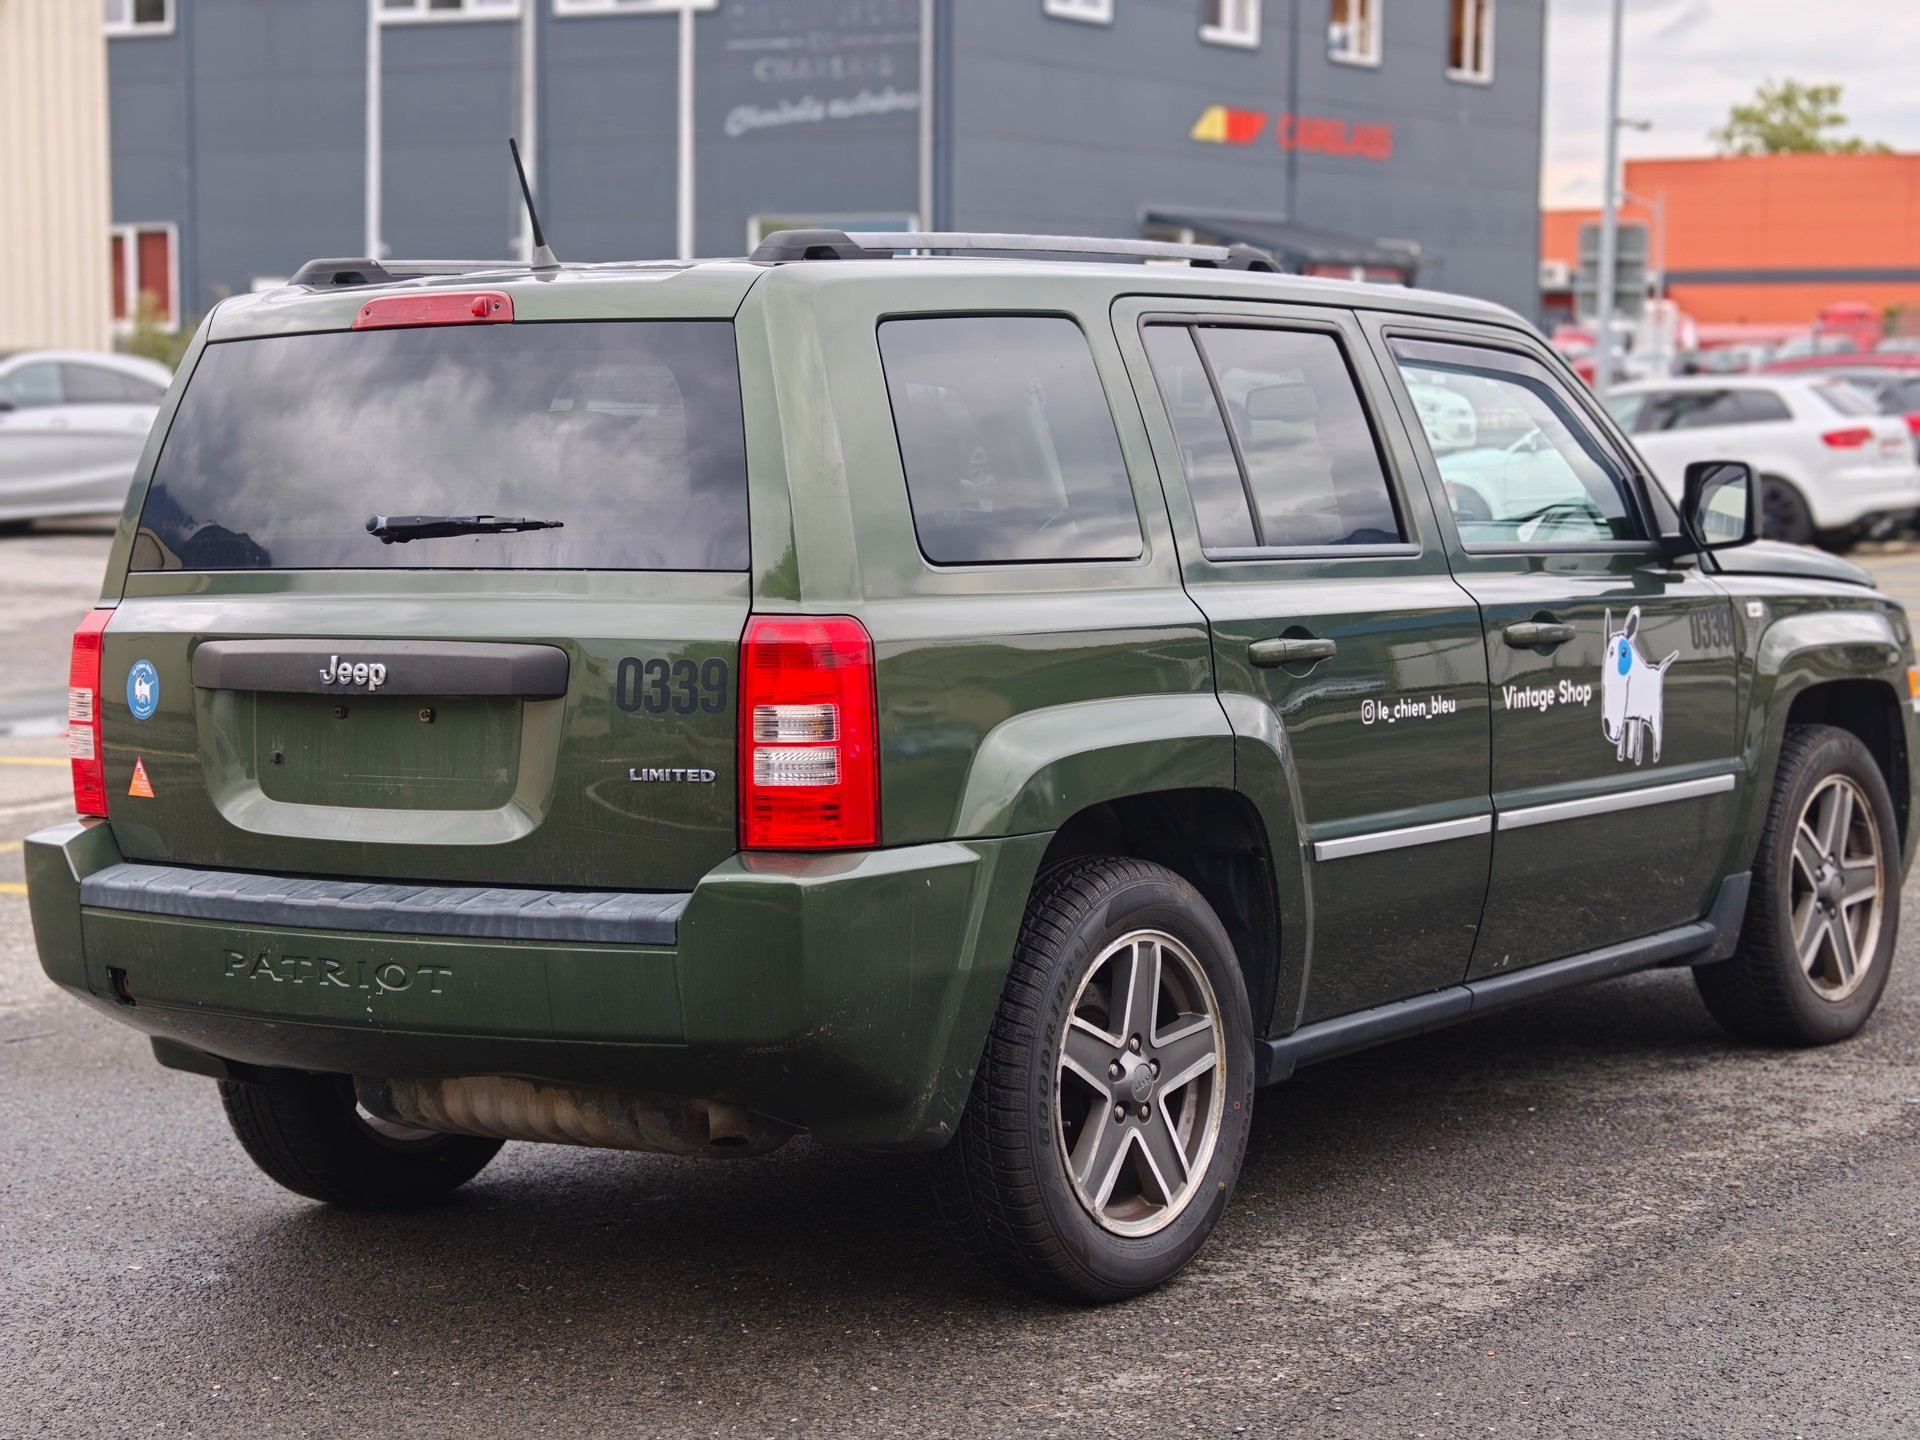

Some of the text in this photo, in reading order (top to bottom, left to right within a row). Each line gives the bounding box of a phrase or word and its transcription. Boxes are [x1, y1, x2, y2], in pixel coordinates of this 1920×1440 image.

[1690, 608, 1733, 650] 0339
[319, 655, 387, 691] Jeep
[616, 656, 729, 715] 0339
[1377, 694, 1456, 723] le_chien_bleu
[1502, 679, 1593, 712] Vintage Shop
[629, 768, 717, 783] LIMITED
[222, 948, 452, 994] PATRIOT
[1039, 962, 1076, 1147] GOODRIDE
